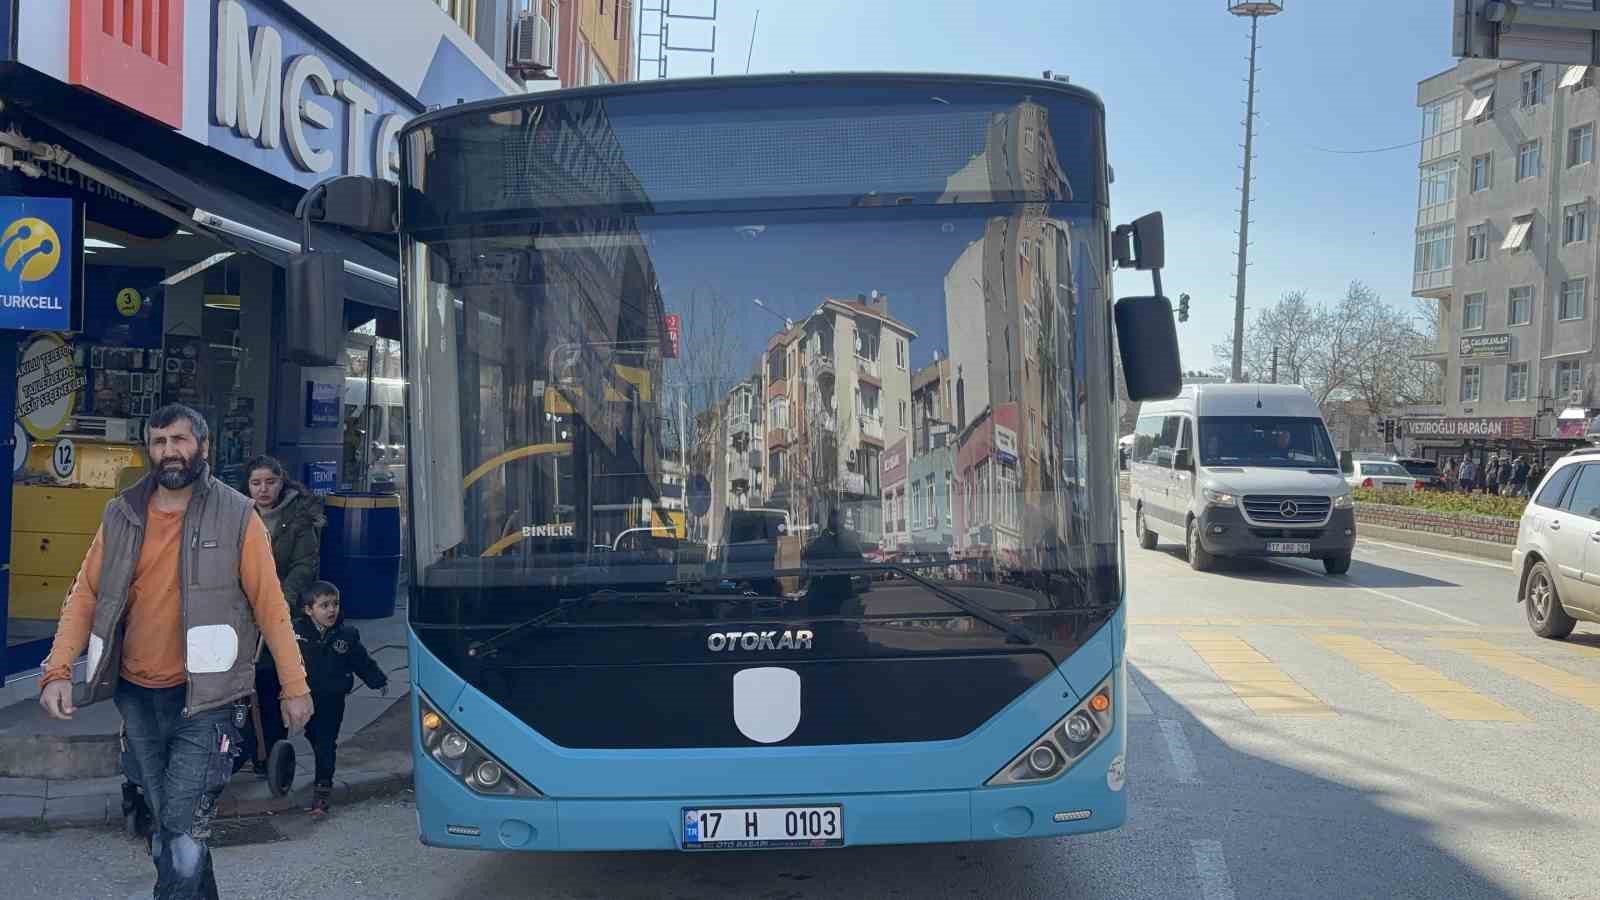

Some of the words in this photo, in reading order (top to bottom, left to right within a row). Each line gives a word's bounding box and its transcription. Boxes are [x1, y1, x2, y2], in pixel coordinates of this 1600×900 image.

[59, 445, 71, 465] 12
[707, 630, 813, 651] OTOKAR
[700, 813, 722, 838] 17
[745, 812, 758, 837] H
[785, 810, 836, 836] 0103
